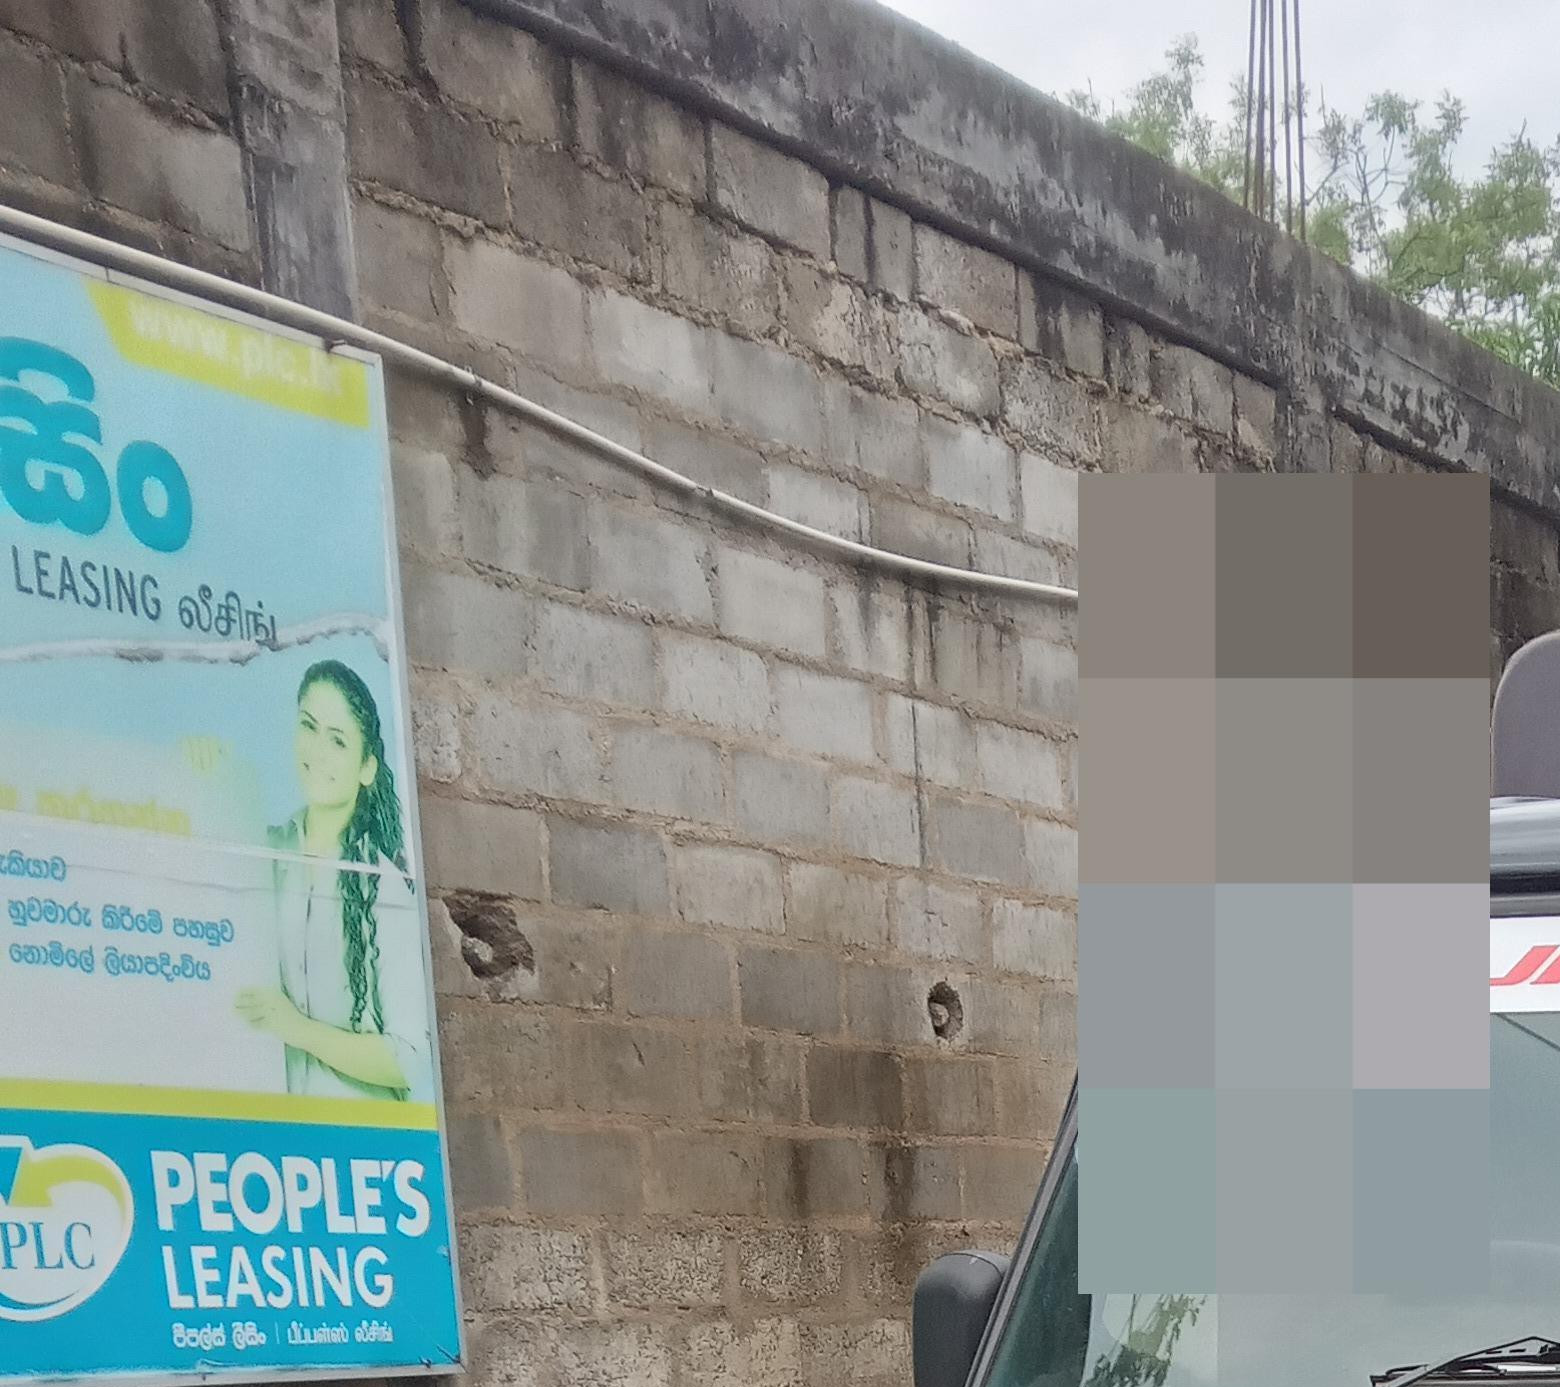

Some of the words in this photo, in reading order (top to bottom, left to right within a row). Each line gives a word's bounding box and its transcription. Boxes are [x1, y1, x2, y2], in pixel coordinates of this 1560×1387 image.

[12, 545, 161, 621] LEASING
[150, 1151, 431, 1237] PEOPLE'S
[1, 1221, 95, 1270] PLC
[161, 1245, 395, 1309] LEASING
